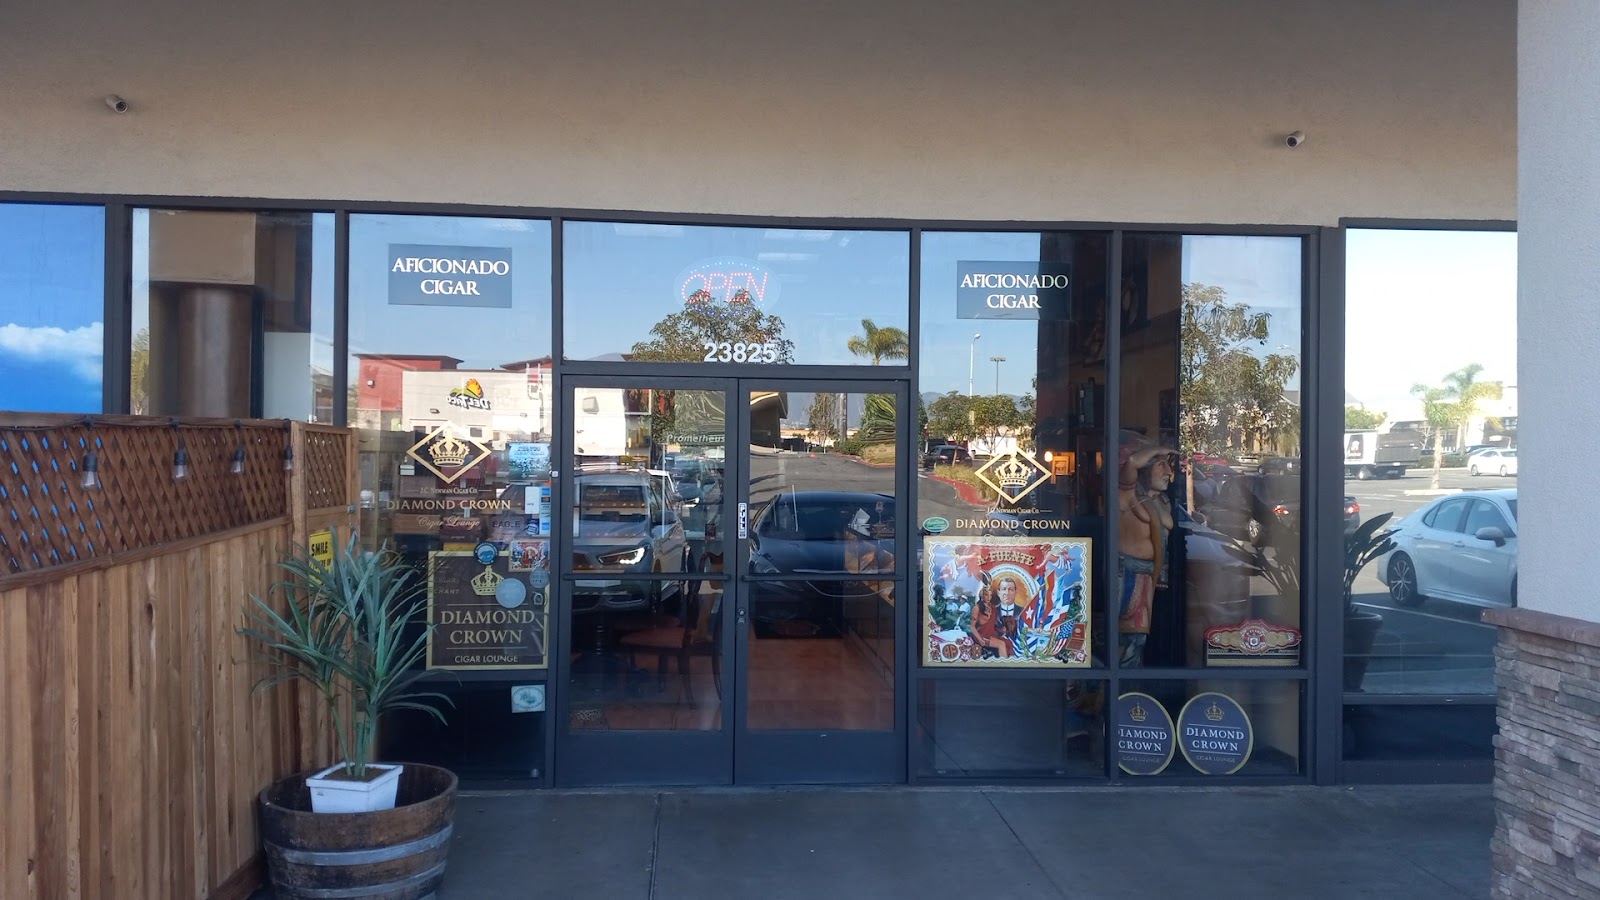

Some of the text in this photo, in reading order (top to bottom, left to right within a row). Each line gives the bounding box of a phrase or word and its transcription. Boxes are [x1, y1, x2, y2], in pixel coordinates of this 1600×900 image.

[391, 257, 510, 276] AFICIONADO
[420, 279, 481, 296] CIGAR
[681, 271, 768, 303] OPEN
[960, 273, 1069, 289] AFICIONADO
[986, 294, 1042, 309] CIGAR
[703, 342, 776, 363] 23825
[386, 499, 511, 510] DIAMOND CROWN
[417, 515, 480, 530] Cigar Lounge
[955, 518, 1019, 530] DIAMOND
[1023, 518, 1070, 530] CROWN
[311, 541, 328, 557] SMILE
[440, 610, 535, 625] DIAMOND
[449, 629, 523, 645] CROWN
[454, 655, 519, 663] CIGAR LOUNGE
[1118, 728, 1168, 740] IAMOND
[1186, 727, 1244, 740] DIAMOND
[1118, 740, 1162, 752] CROWN
[1192, 740, 1238, 751] CROWN
